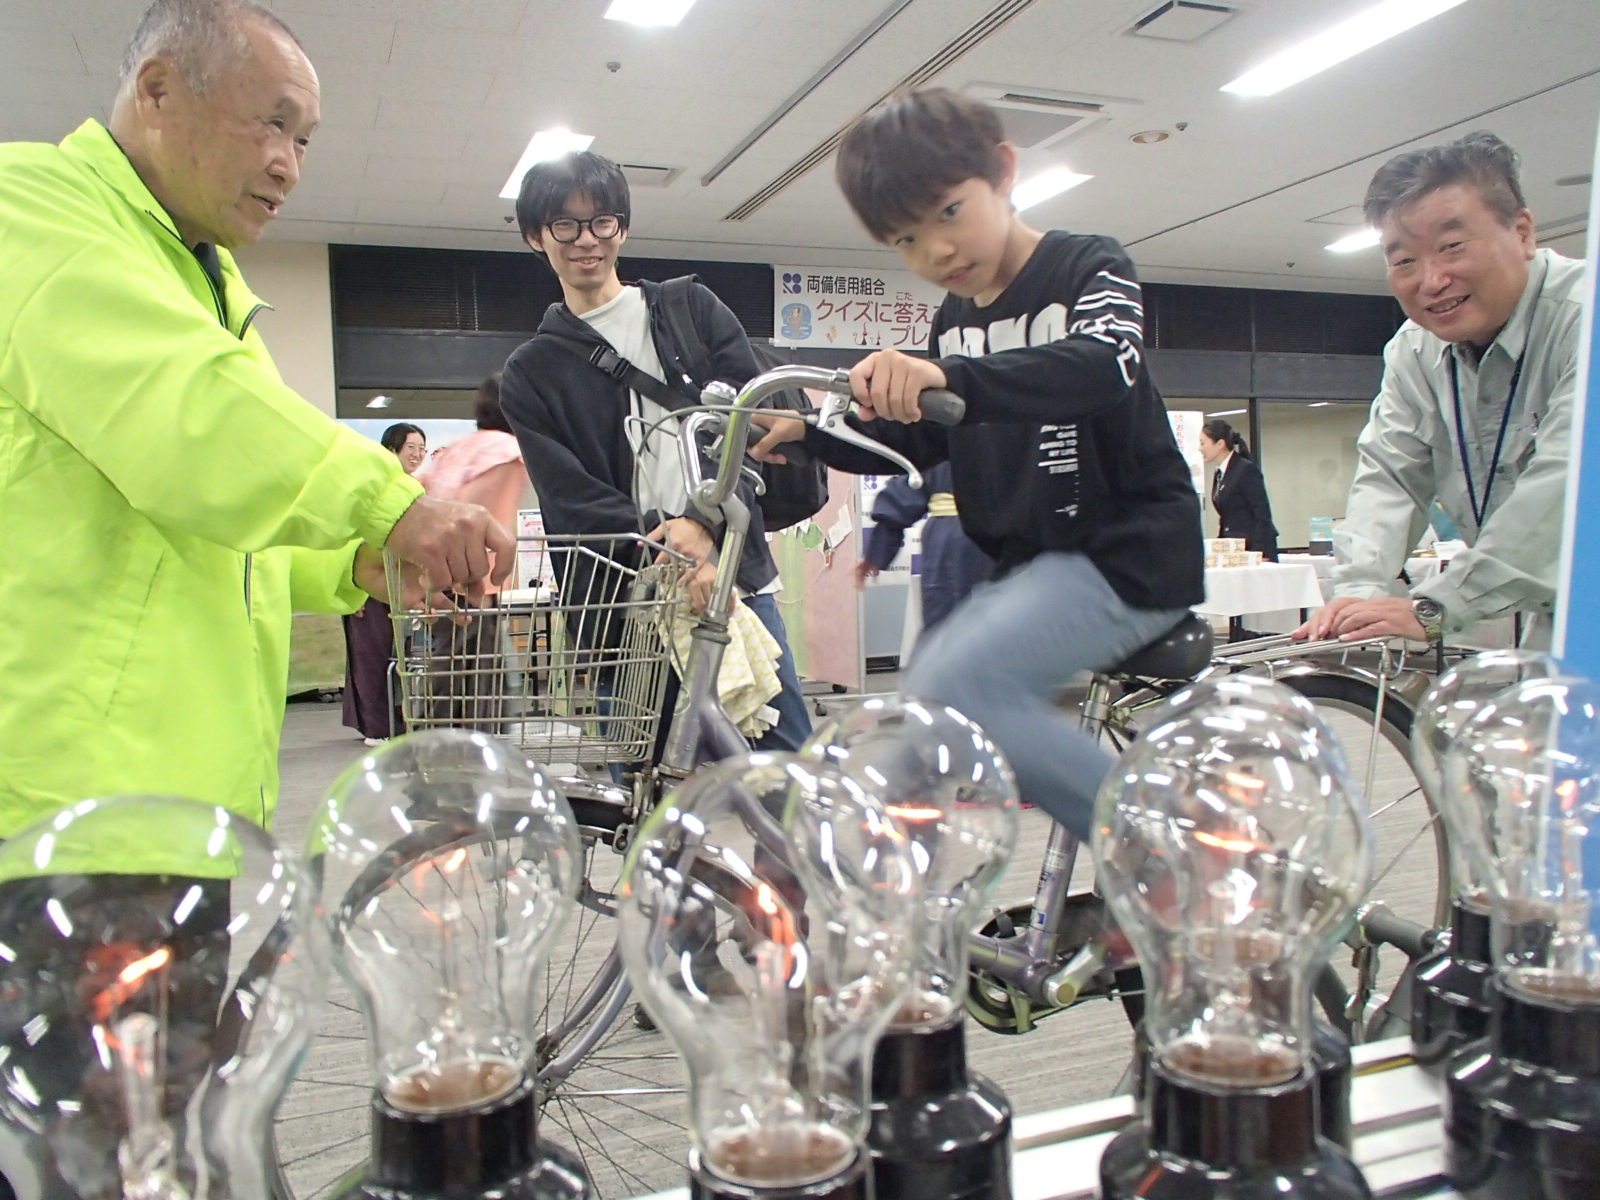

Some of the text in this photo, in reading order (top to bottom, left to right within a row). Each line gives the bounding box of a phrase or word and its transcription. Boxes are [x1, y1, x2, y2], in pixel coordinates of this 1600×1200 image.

[807, 275, 885, 296] 両備信用組合
[896, 291, 913, 301] こた
[816, 299, 941, 324] クイズに答え
